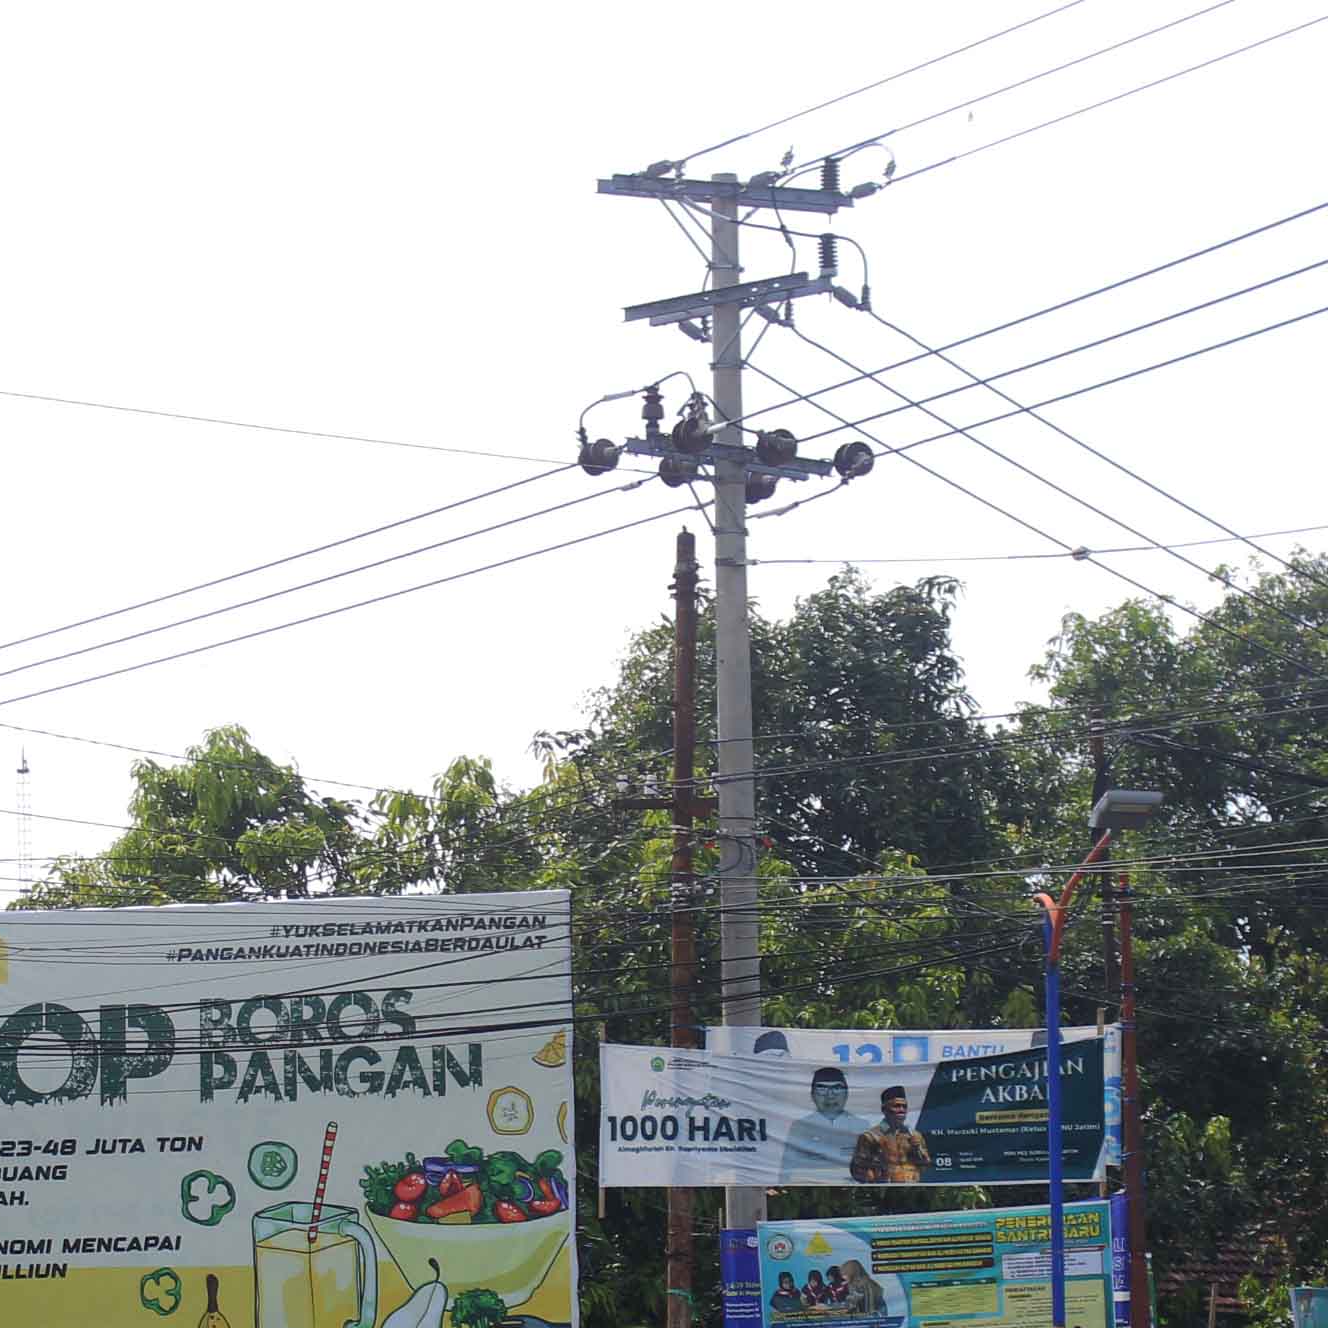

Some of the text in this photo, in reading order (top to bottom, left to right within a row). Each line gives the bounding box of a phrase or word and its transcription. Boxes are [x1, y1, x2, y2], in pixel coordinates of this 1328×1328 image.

[199, 989, 416, 1046] BOROS
[199, 1042, 483, 1103] PANGAN
[951, 1056, 1085, 1082] PENGAJIN
[981, 1083, 1050, 1105] AKBA
[607, 1114, 768, 1142] 1000 HARI
[0, 1139, 76, 1157] 23-48
[86, 1137, 146, 1155] JUTA
[157, 1136, 203, 1152] TON
[62, 1235, 182, 1254] MENCAPAI
